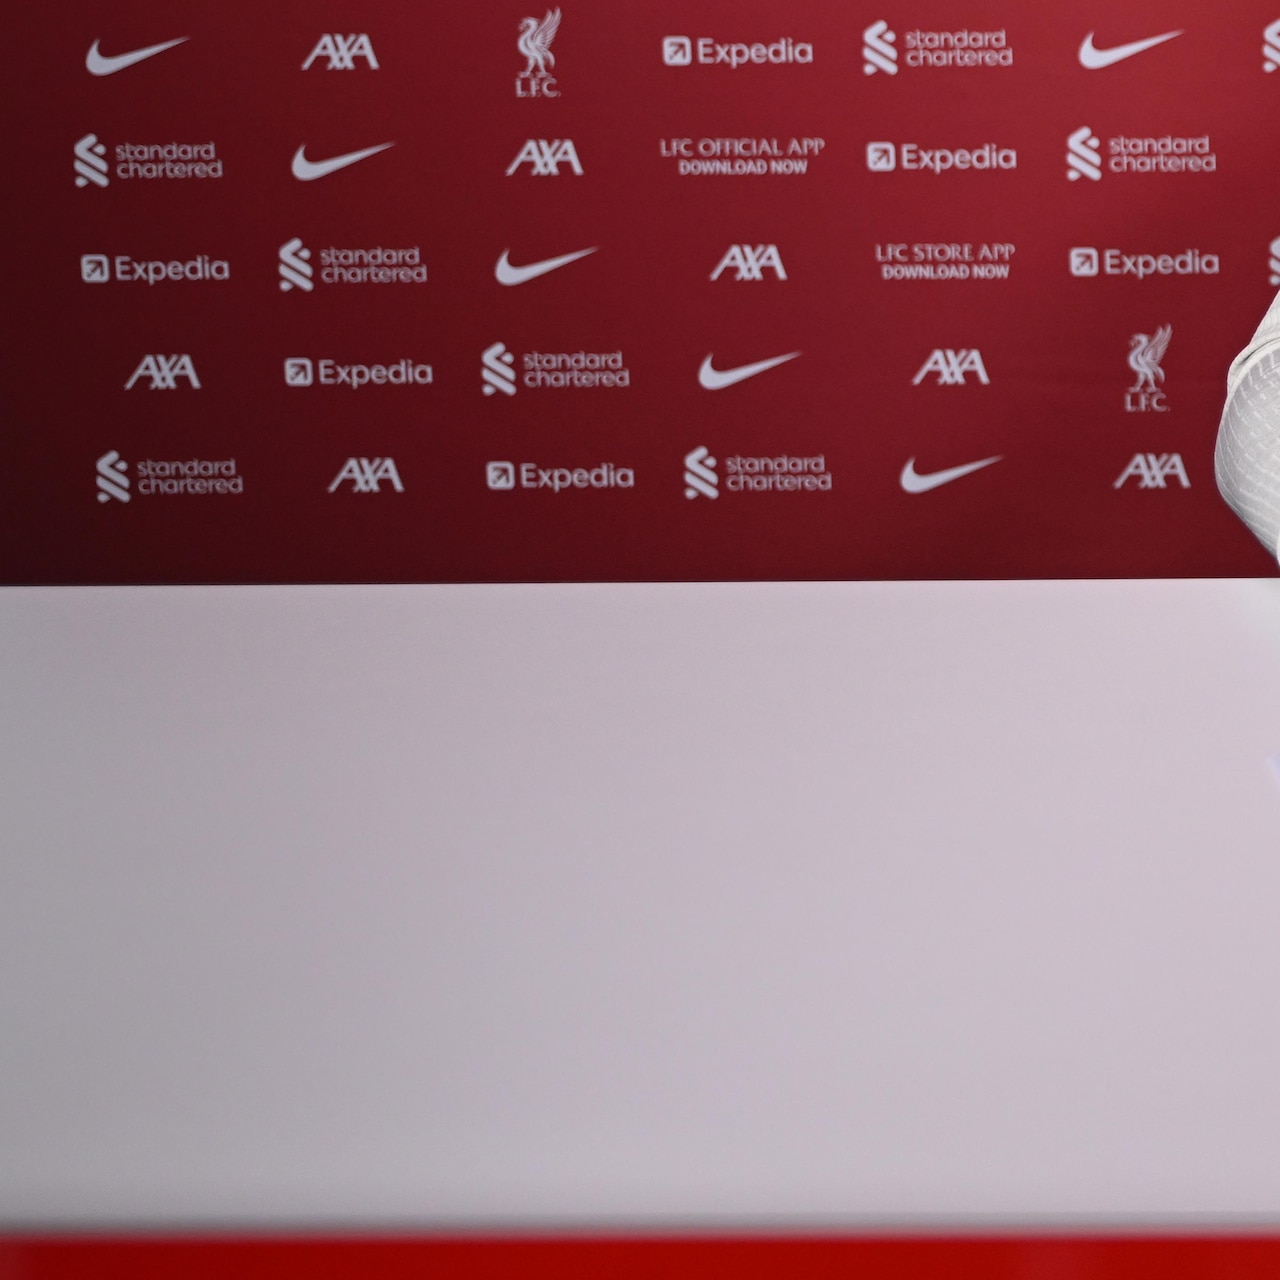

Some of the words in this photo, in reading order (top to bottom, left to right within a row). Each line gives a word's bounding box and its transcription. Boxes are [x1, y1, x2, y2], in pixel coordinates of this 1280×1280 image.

[697, 37, 814, 69] Expedia
[115, 141, 218, 161] standard
[1108, 135, 1210, 154] standard
[506, 139, 584, 176] AXA
[1108, 153, 1217, 173] chartered
[116, 160, 224, 179] chartered
[875, 243, 908, 262] LFC
[912, 243, 974, 262] STORE
[978, 243, 1016, 261] APP
[114, 254, 230, 286] Expedia
[881, 263, 971, 280] DOWNLOAD
[971, 263, 1010, 280] NOW
[1103, 248, 1220, 279] Expedia
[124, 354, 201, 390] AXA
[912, 348, 990, 385] AXA
[136, 458, 238, 477] standard
[725, 454, 827, 473] standard
[137, 476, 244, 495] chartered
[520, 462, 635, 493] Expedia
[725, 472, 833, 492] chartered
